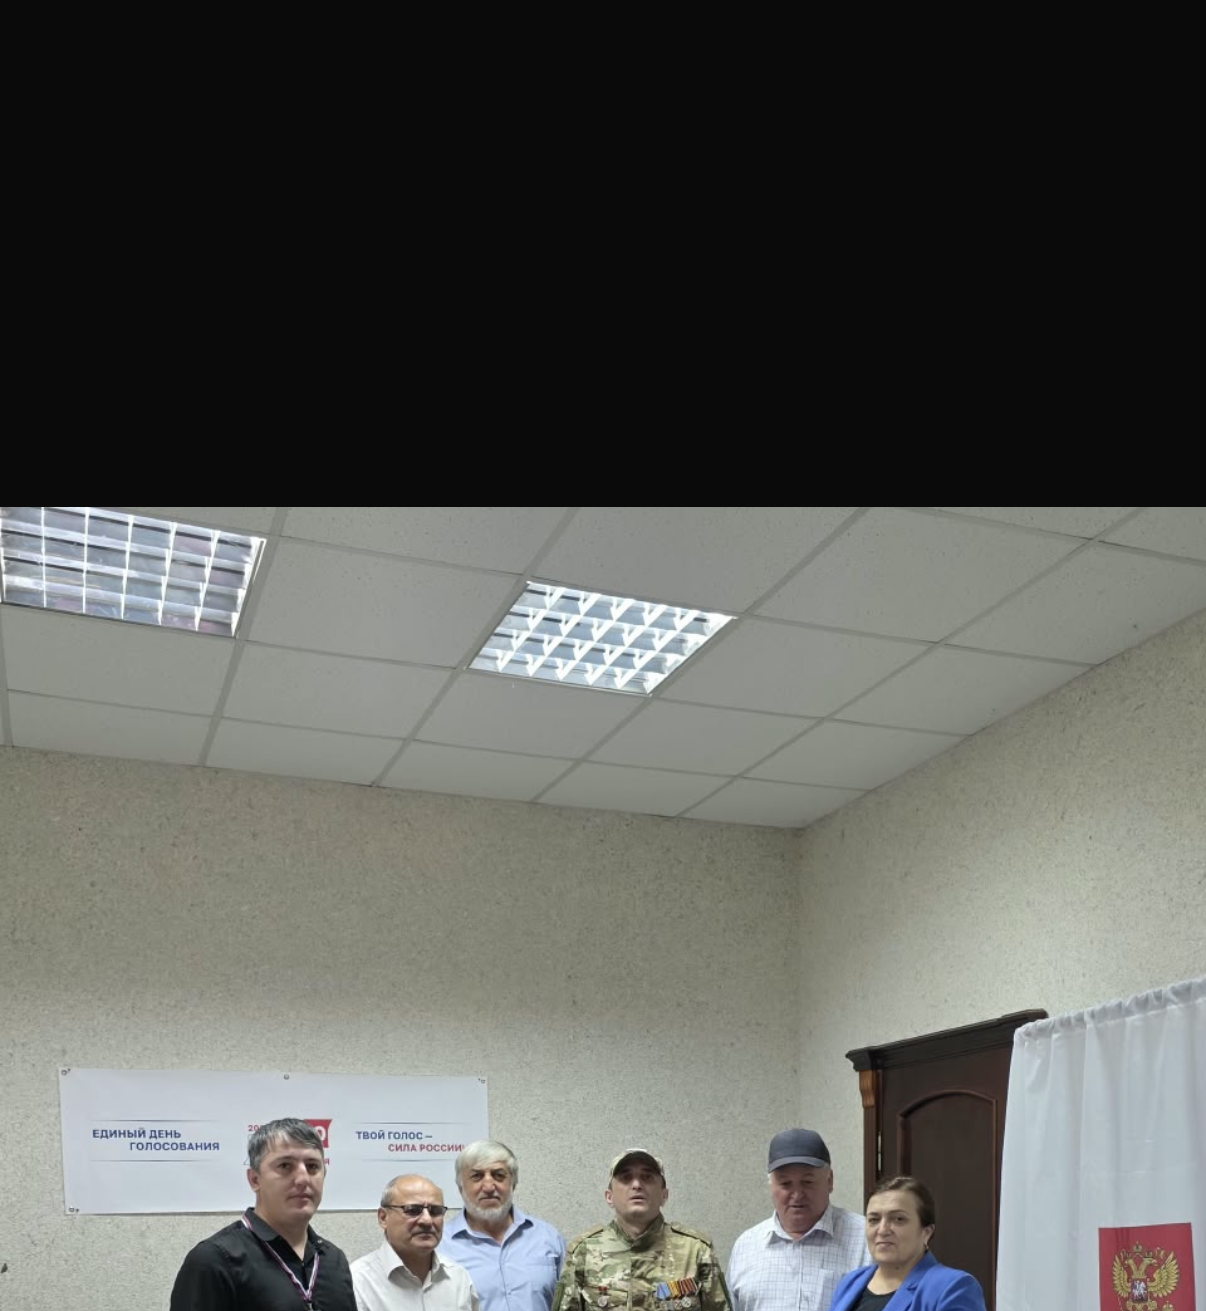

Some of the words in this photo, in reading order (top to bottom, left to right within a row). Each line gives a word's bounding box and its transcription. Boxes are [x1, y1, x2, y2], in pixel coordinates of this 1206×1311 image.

[92, 1127, 146, 1139] ЕДИНЫЙ
[149, 1129, 182, 1139] ДЕНЬ
[356, 1130, 385, 1140] ТВОЙ
[387, 1131, 423, 1140] ГОЛОС
[129, 1142, 220, 1151] ГОЛОСОВАНИЯ
[388, 1143, 417, 1152] СИЛА
